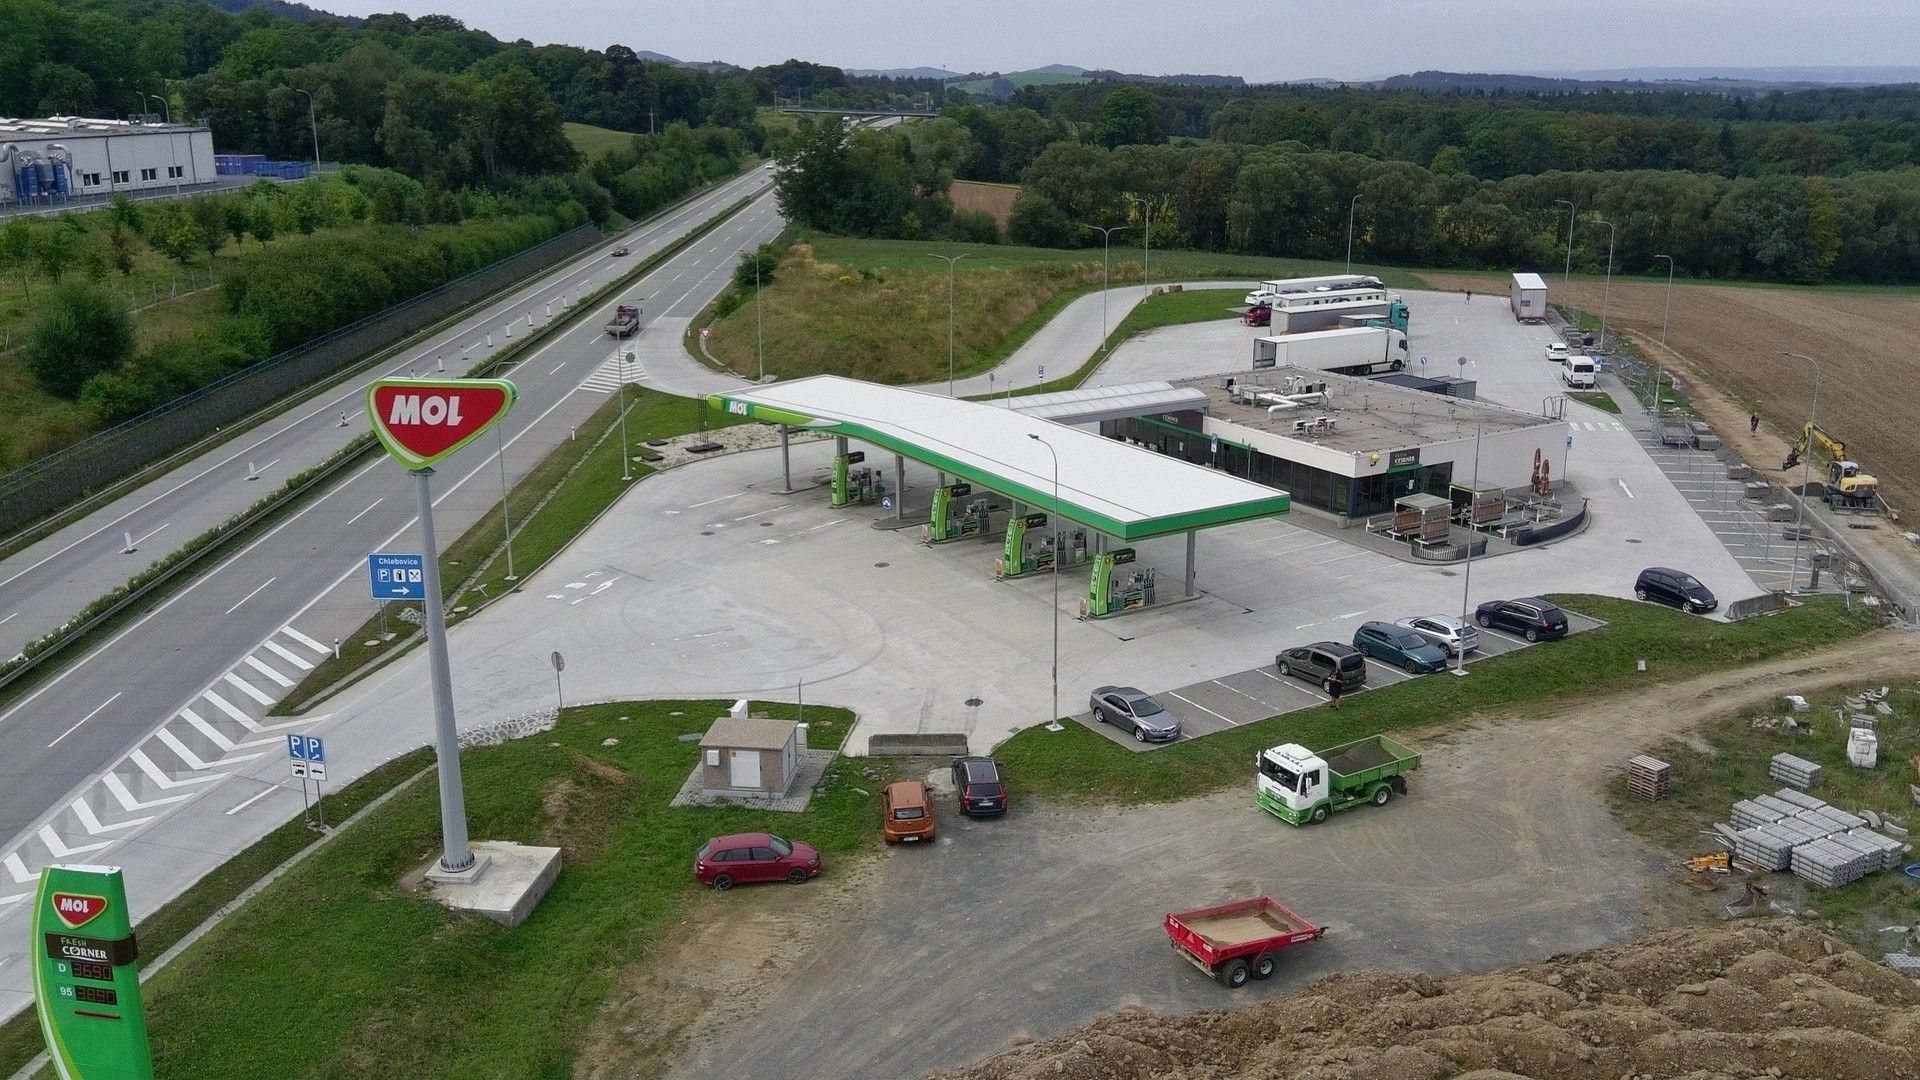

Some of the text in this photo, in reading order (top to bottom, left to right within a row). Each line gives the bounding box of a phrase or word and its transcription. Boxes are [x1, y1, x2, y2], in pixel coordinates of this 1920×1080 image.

[389, 395, 463, 426] MOL
[729, 401, 747, 415] MOL
[290, 736, 300, 750] P
[310, 738, 319, 753] P
[60, 898, 89, 913] MOL
[61, 937, 87, 947] FRESH
[59, 963, 66, 973] D
[60, 986, 72, 997] 95
